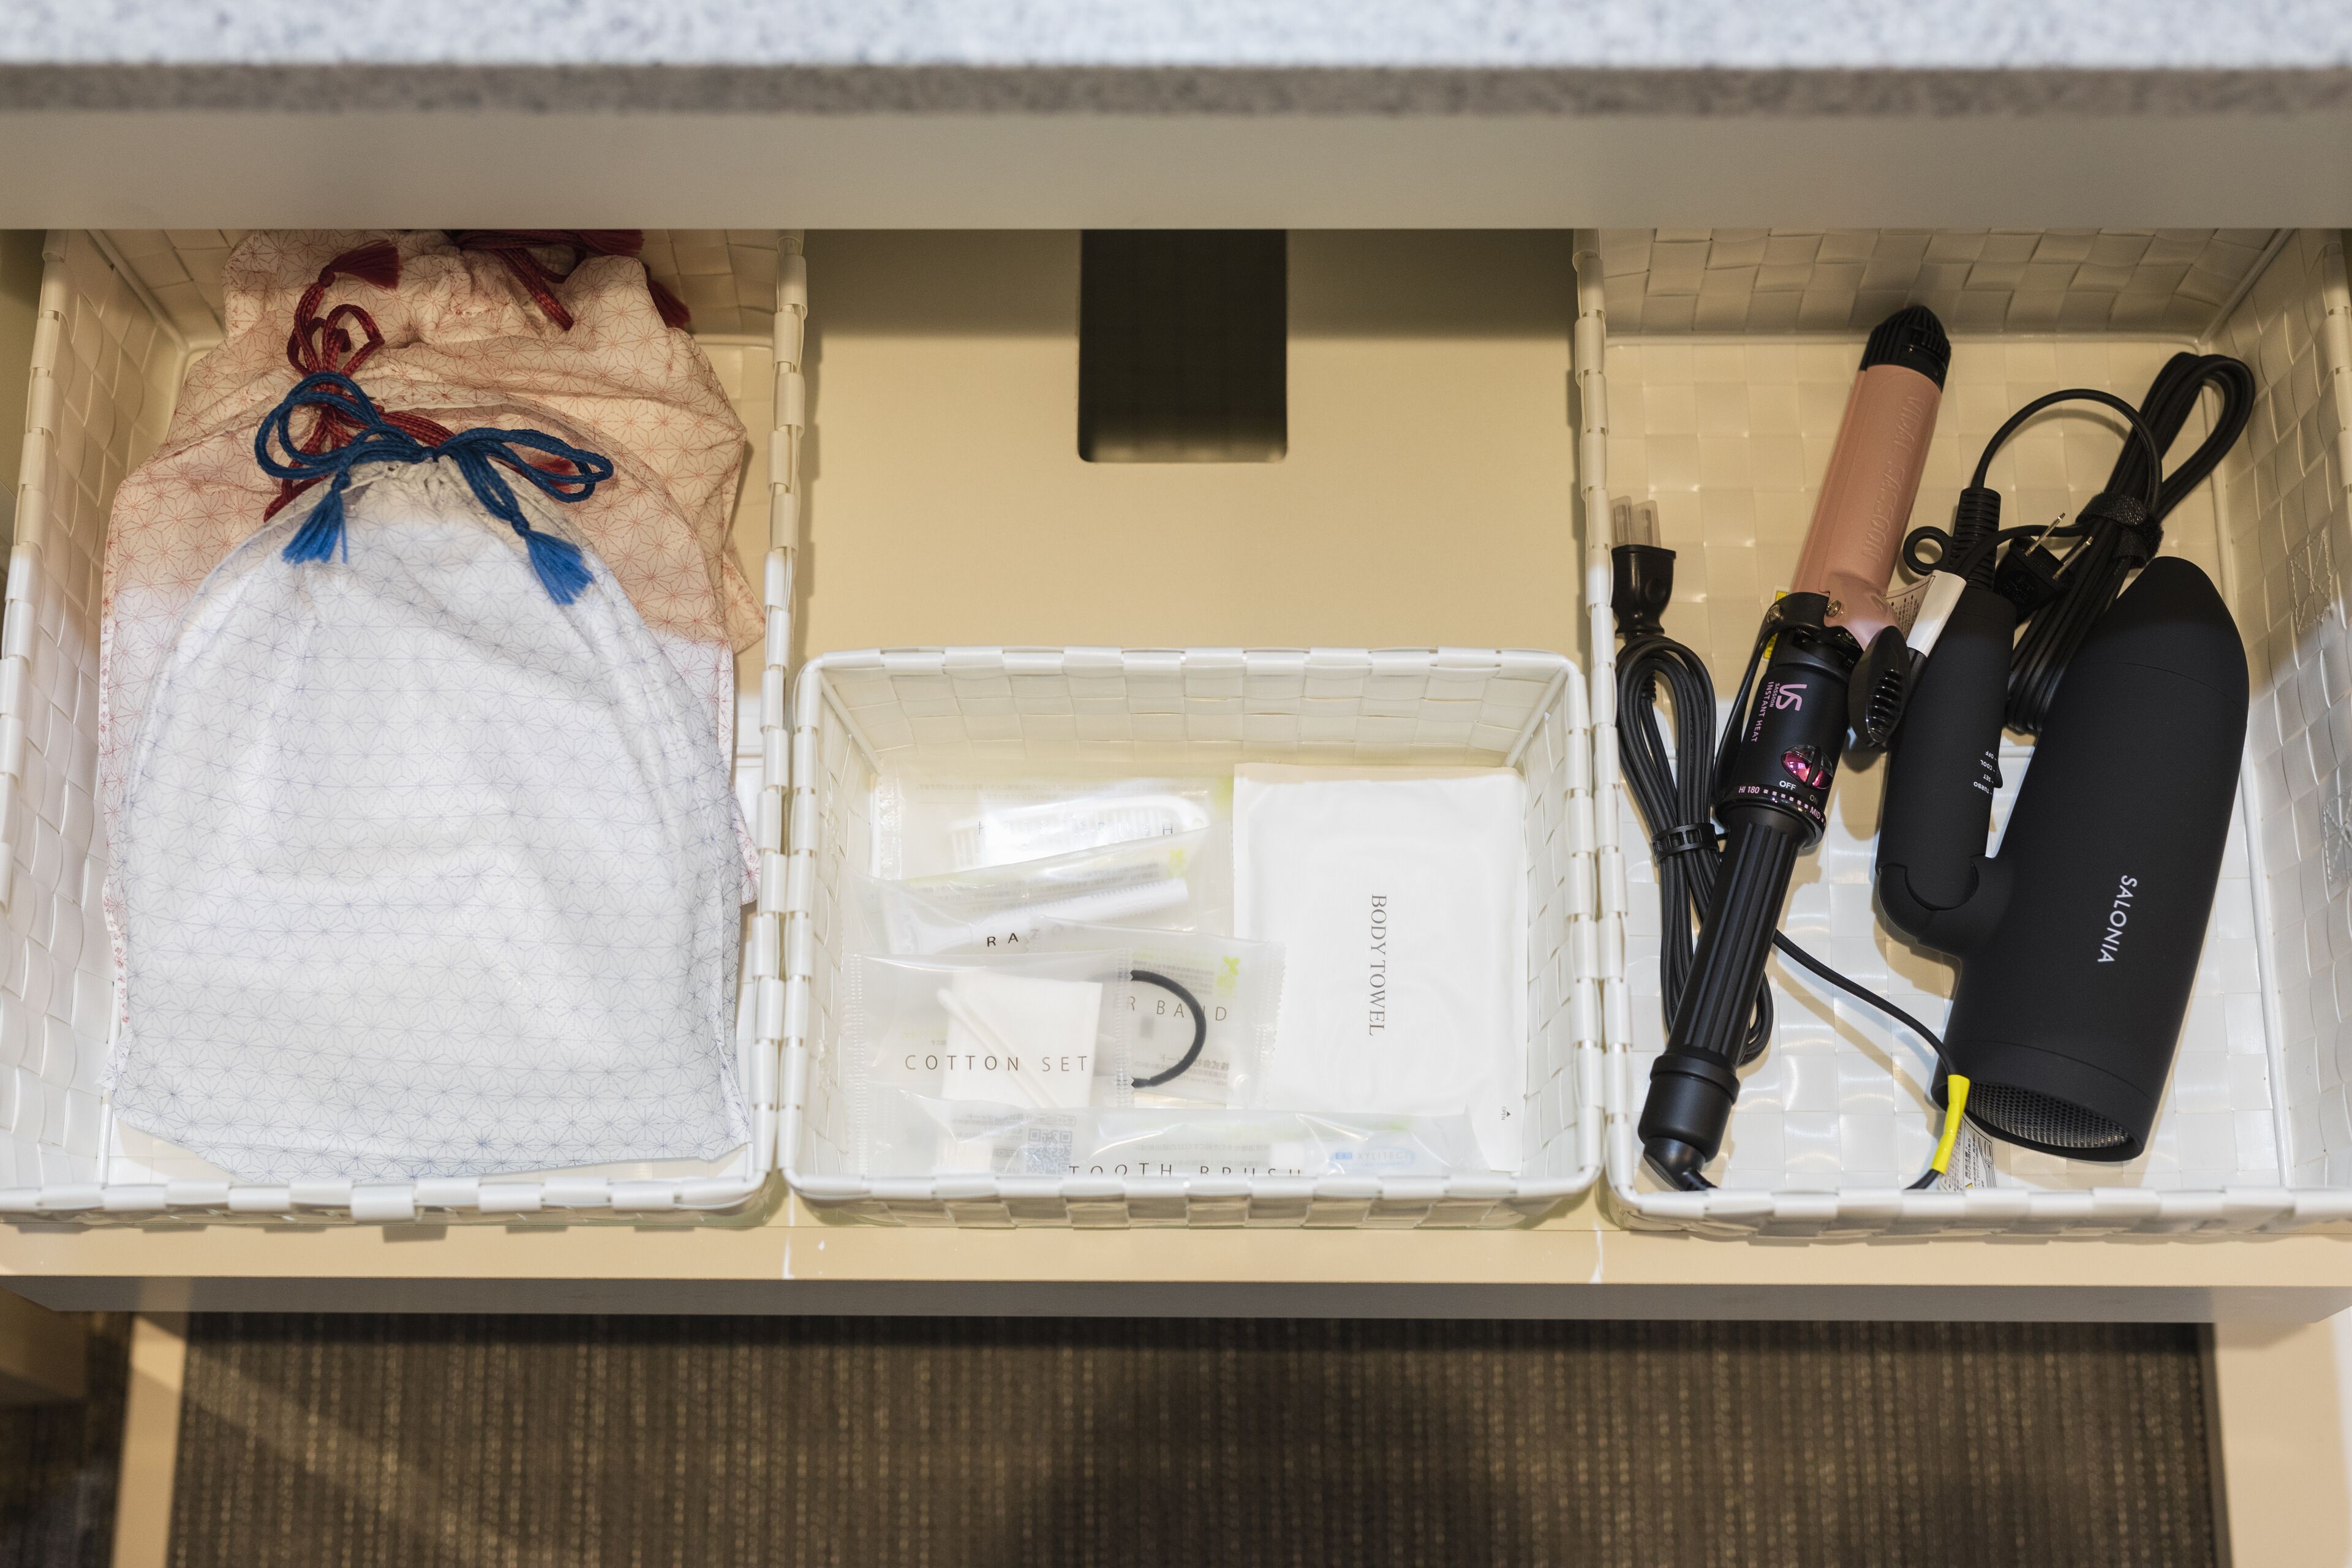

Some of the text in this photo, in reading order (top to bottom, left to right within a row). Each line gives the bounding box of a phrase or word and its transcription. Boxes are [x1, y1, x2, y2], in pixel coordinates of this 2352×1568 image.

[1863, 461, 1905, 563] SASSOON
[1769, 683, 1780, 707] SASSOON
[1751, 682, 1774, 742] INSTANT HEAT
[1980, 760, 1992, 771] COOL
[1779, 780, 1796, 790] OFF
[1973, 782, 1989, 794] TURBO
[1809, 794, 1819, 805] ON
[1810, 806, 1821, 819] MID
[2097, 875, 2138, 962] SALONIA
[1369, 894, 1387, 1036] BODY TOWEL
[905, 1055, 1087, 1072] COTTON SET
